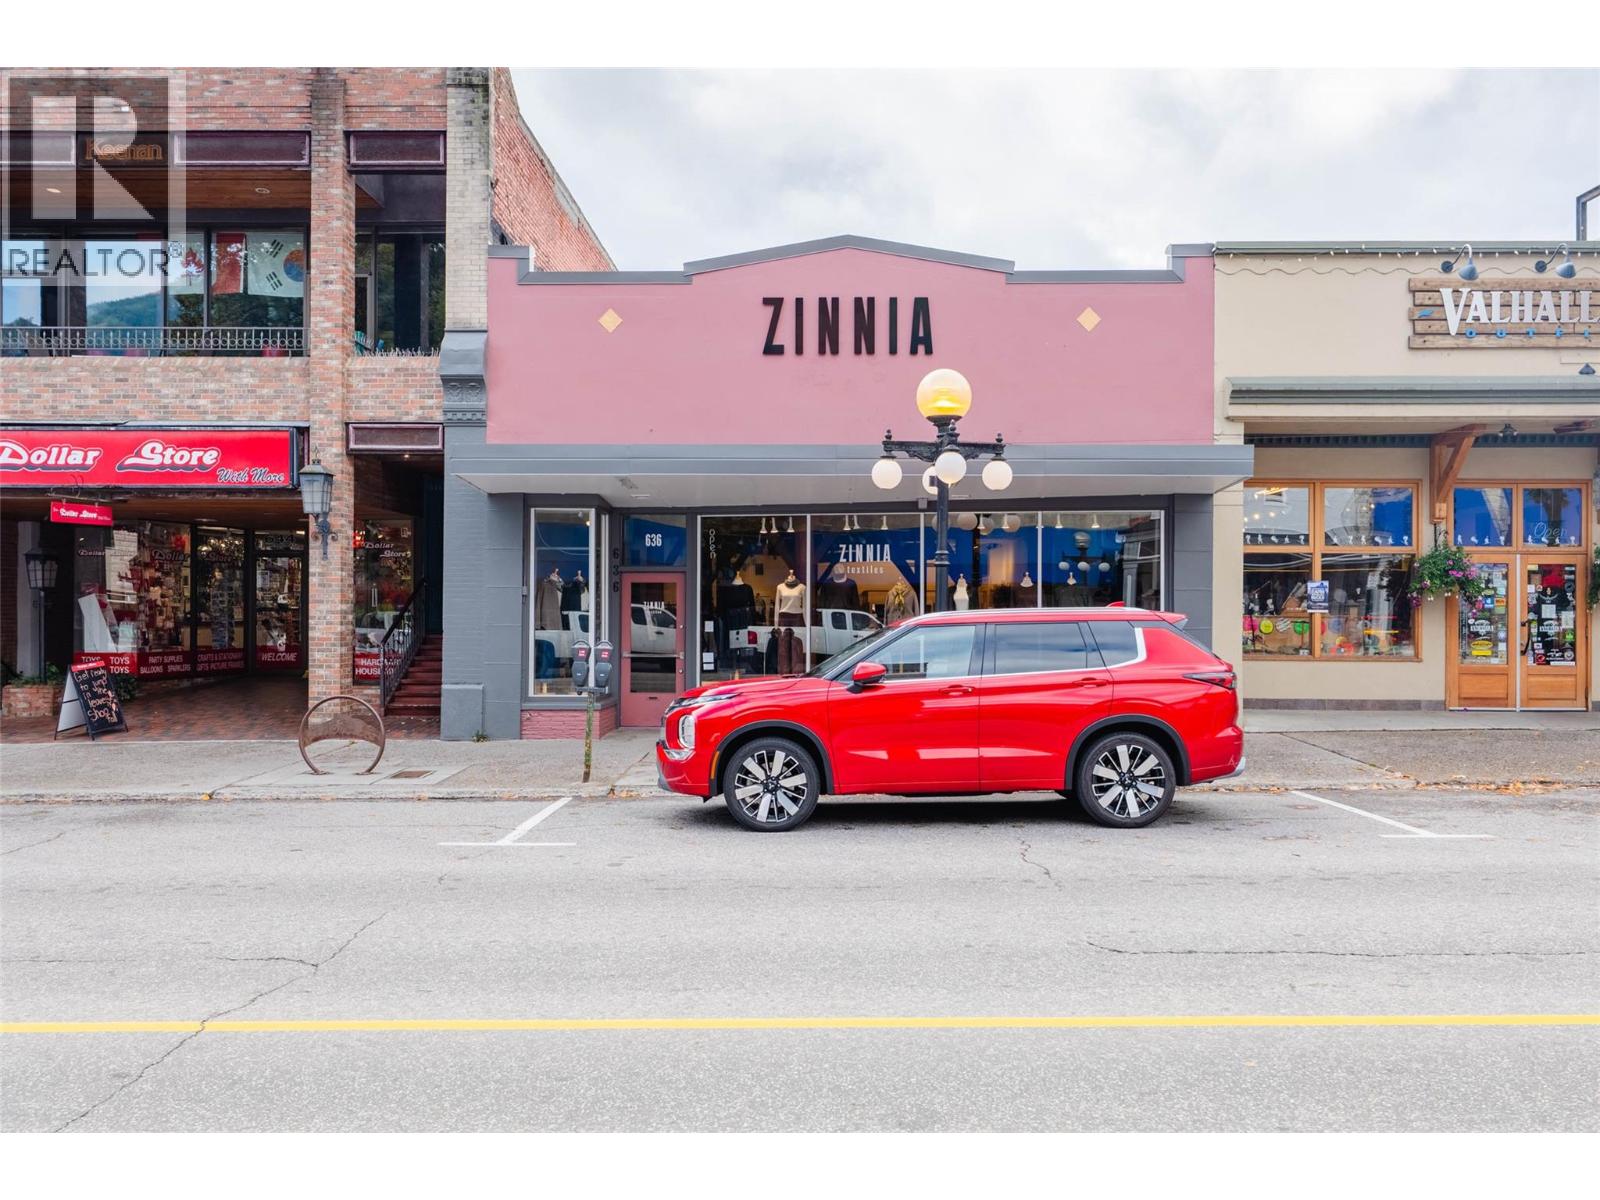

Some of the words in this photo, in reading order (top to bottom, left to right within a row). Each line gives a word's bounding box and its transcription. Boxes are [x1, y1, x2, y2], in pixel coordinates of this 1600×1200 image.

[85, 138, 164, 160] Keenan
[1440, 288, 1600, 336] VALHALL
[762, 297, 933, 356] ZINNIA
[0, 440, 102, 468] Dollar
[118, 440, 220, 468] Store
[217, 468, 248, 482] With
[250, 468, 285, 482] More
[1533, 521, 1568, 538] Open
[645, 533, 662, 547] 636
[152, 549, 190, 561] Dollar
[839, 544, 891, 562] ZINNIA
[847, 564, 884, 574] textiles
[109, 656, 130, 665] TOYS
[261, 652, 298, 662] WELCOME
[73, 670, 89, 683] Get
[91, 667, 107, 680] ready
[109, 666, 130, 674] TOYS
[140, 666, 163, 675] BALLOONS
